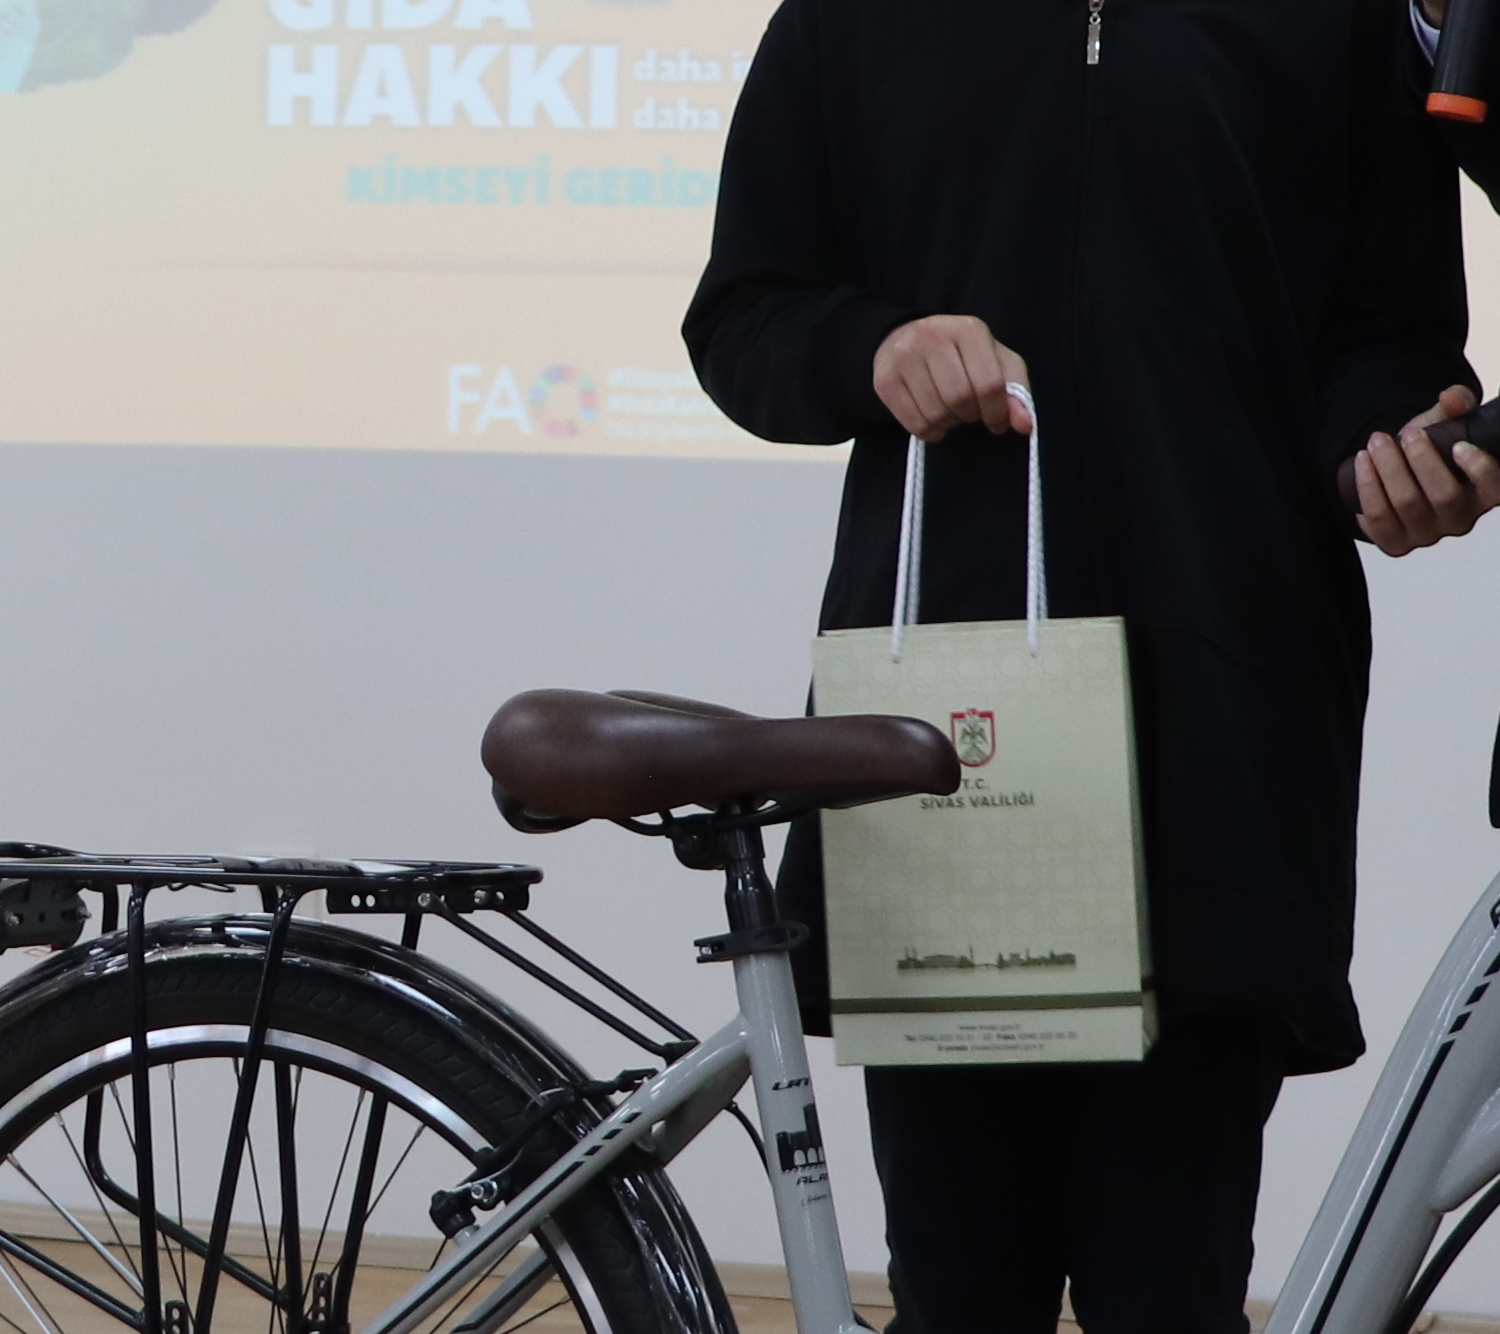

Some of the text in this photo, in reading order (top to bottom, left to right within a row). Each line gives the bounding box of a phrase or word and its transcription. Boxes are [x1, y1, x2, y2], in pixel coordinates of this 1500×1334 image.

[266, 42, 619, 129] HAKKI
[633, 46, 722, 83] daha
[632, 96, 722, 132] daha
[346, 153, 721, 207] KİMSEYİ GERİD
[921, 790, 1034, 809] SİVAS VALİLİĞİ
[961, 778, 990, 790] T.C.
